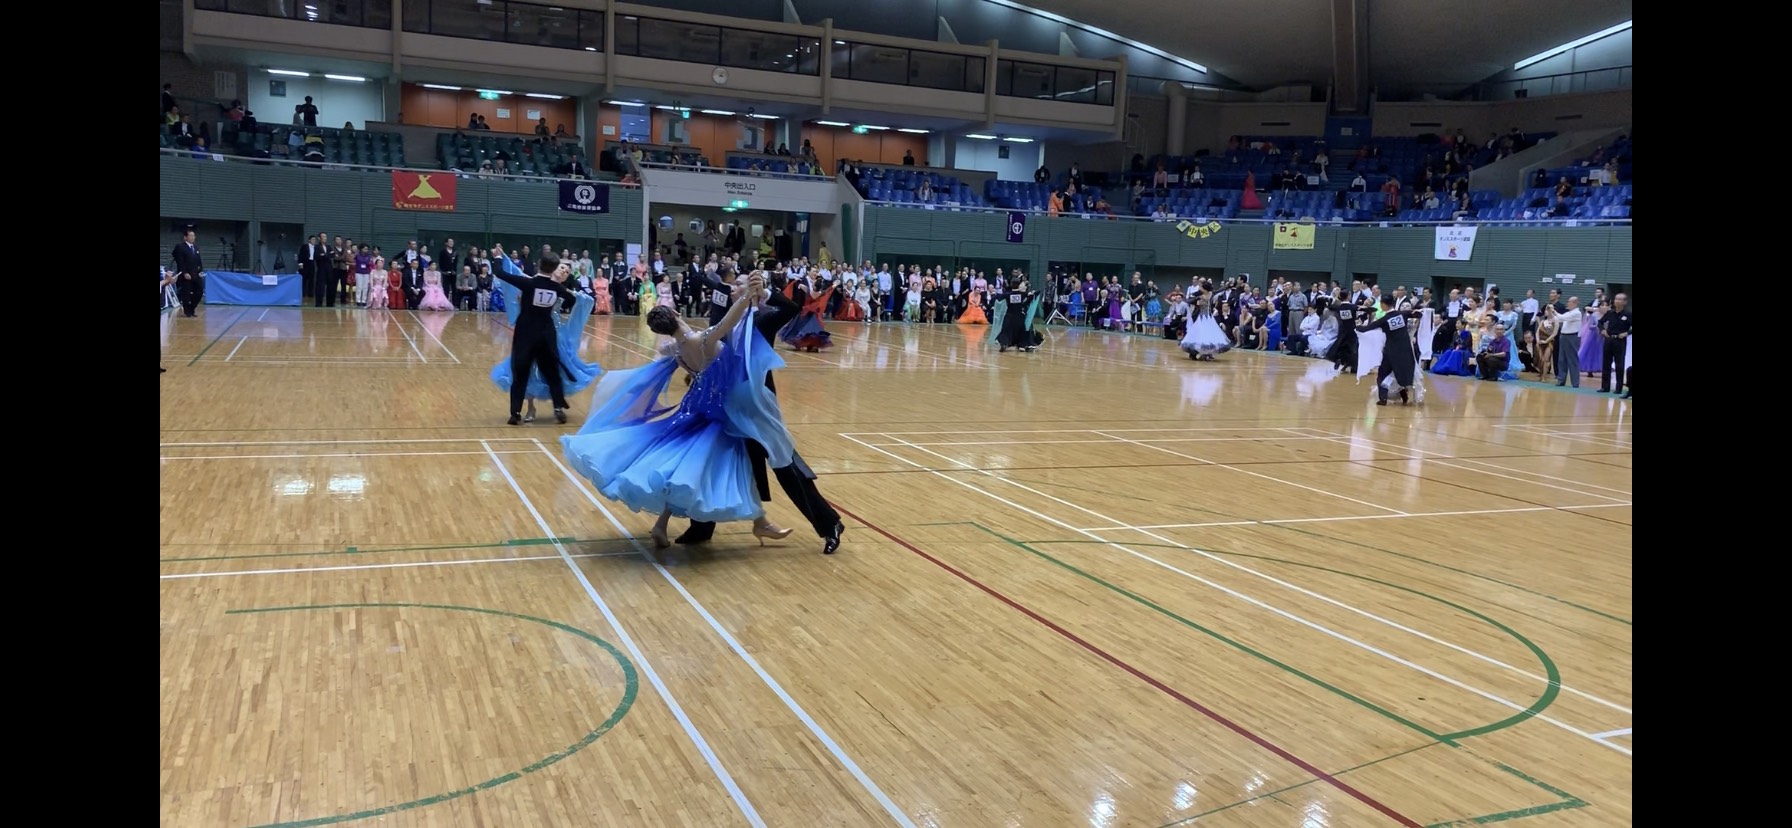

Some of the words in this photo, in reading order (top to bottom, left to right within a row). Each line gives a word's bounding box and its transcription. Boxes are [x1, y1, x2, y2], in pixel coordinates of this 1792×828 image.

[724, 182, 756, 190] 中央出入口
[538, 291, 554, 304] 17
[714, 292, 726, 303] 10
[1390, 316, 1403, 327] 52
